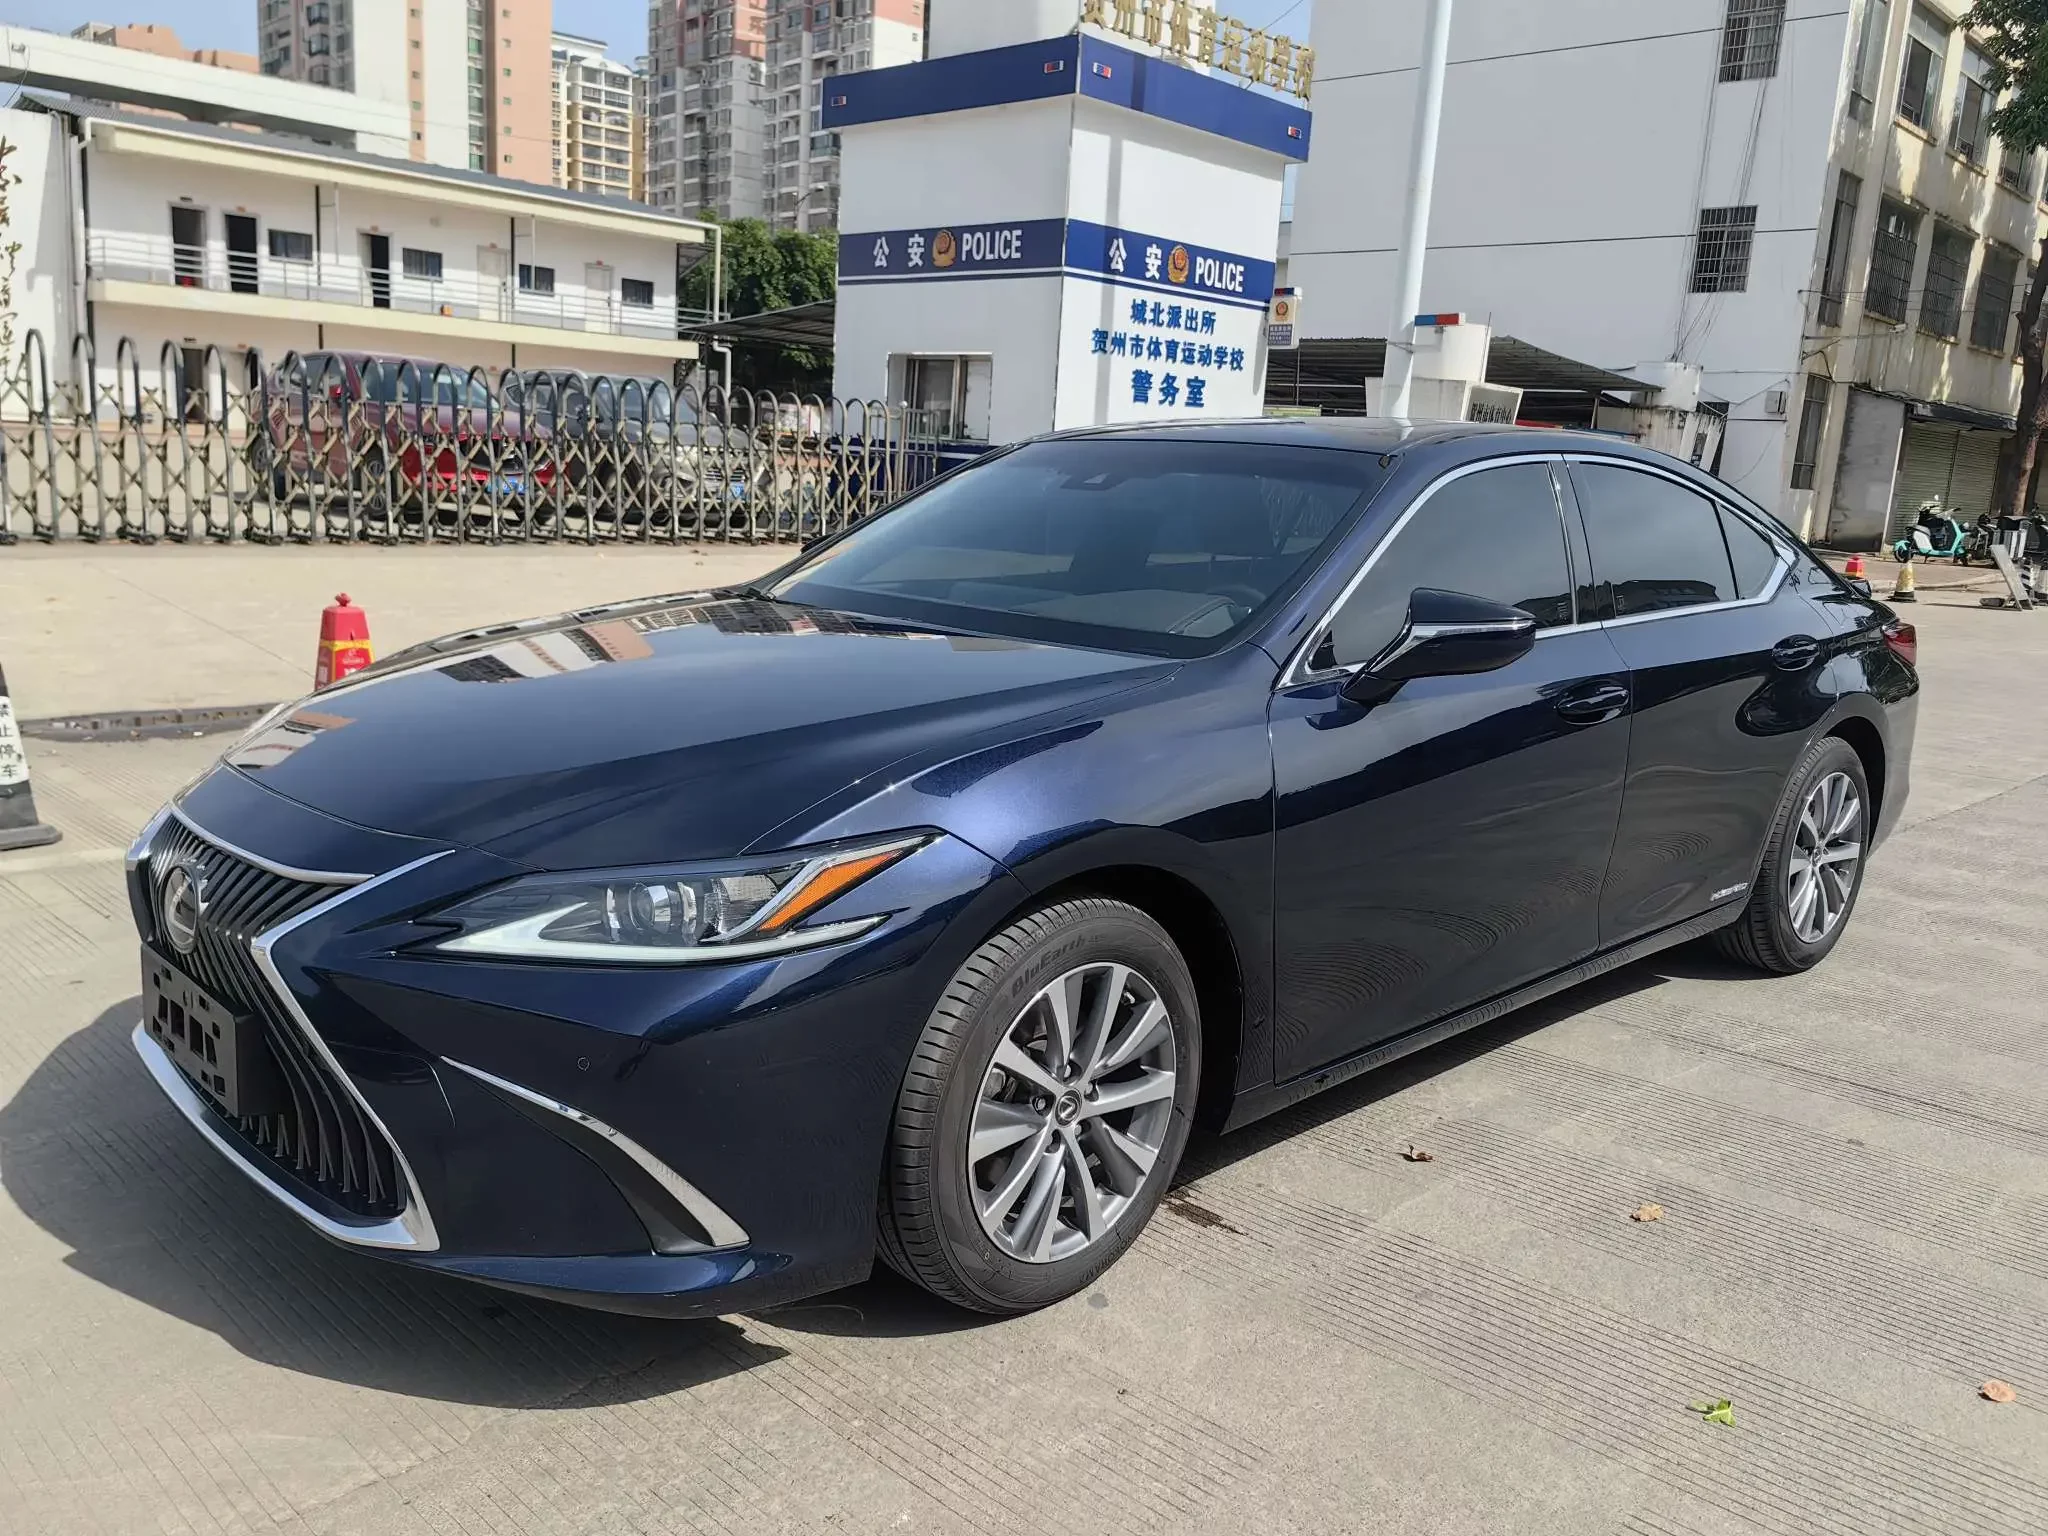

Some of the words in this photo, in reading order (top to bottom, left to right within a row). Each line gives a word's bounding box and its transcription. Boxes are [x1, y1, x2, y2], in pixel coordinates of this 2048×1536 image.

[872, 233, 926, 268] 公安
[961, 229, 1022, 261] POLICE
[1108, 237, 1163, 280] 公安
[1194, 255, 1244, 293] POLICE
[1130, 298, 1217, 336] 城北派出所
[1091, 328, 1245, 372] 贺州市体育运动学校
[1130, 368, 1206, 408] 警务室
